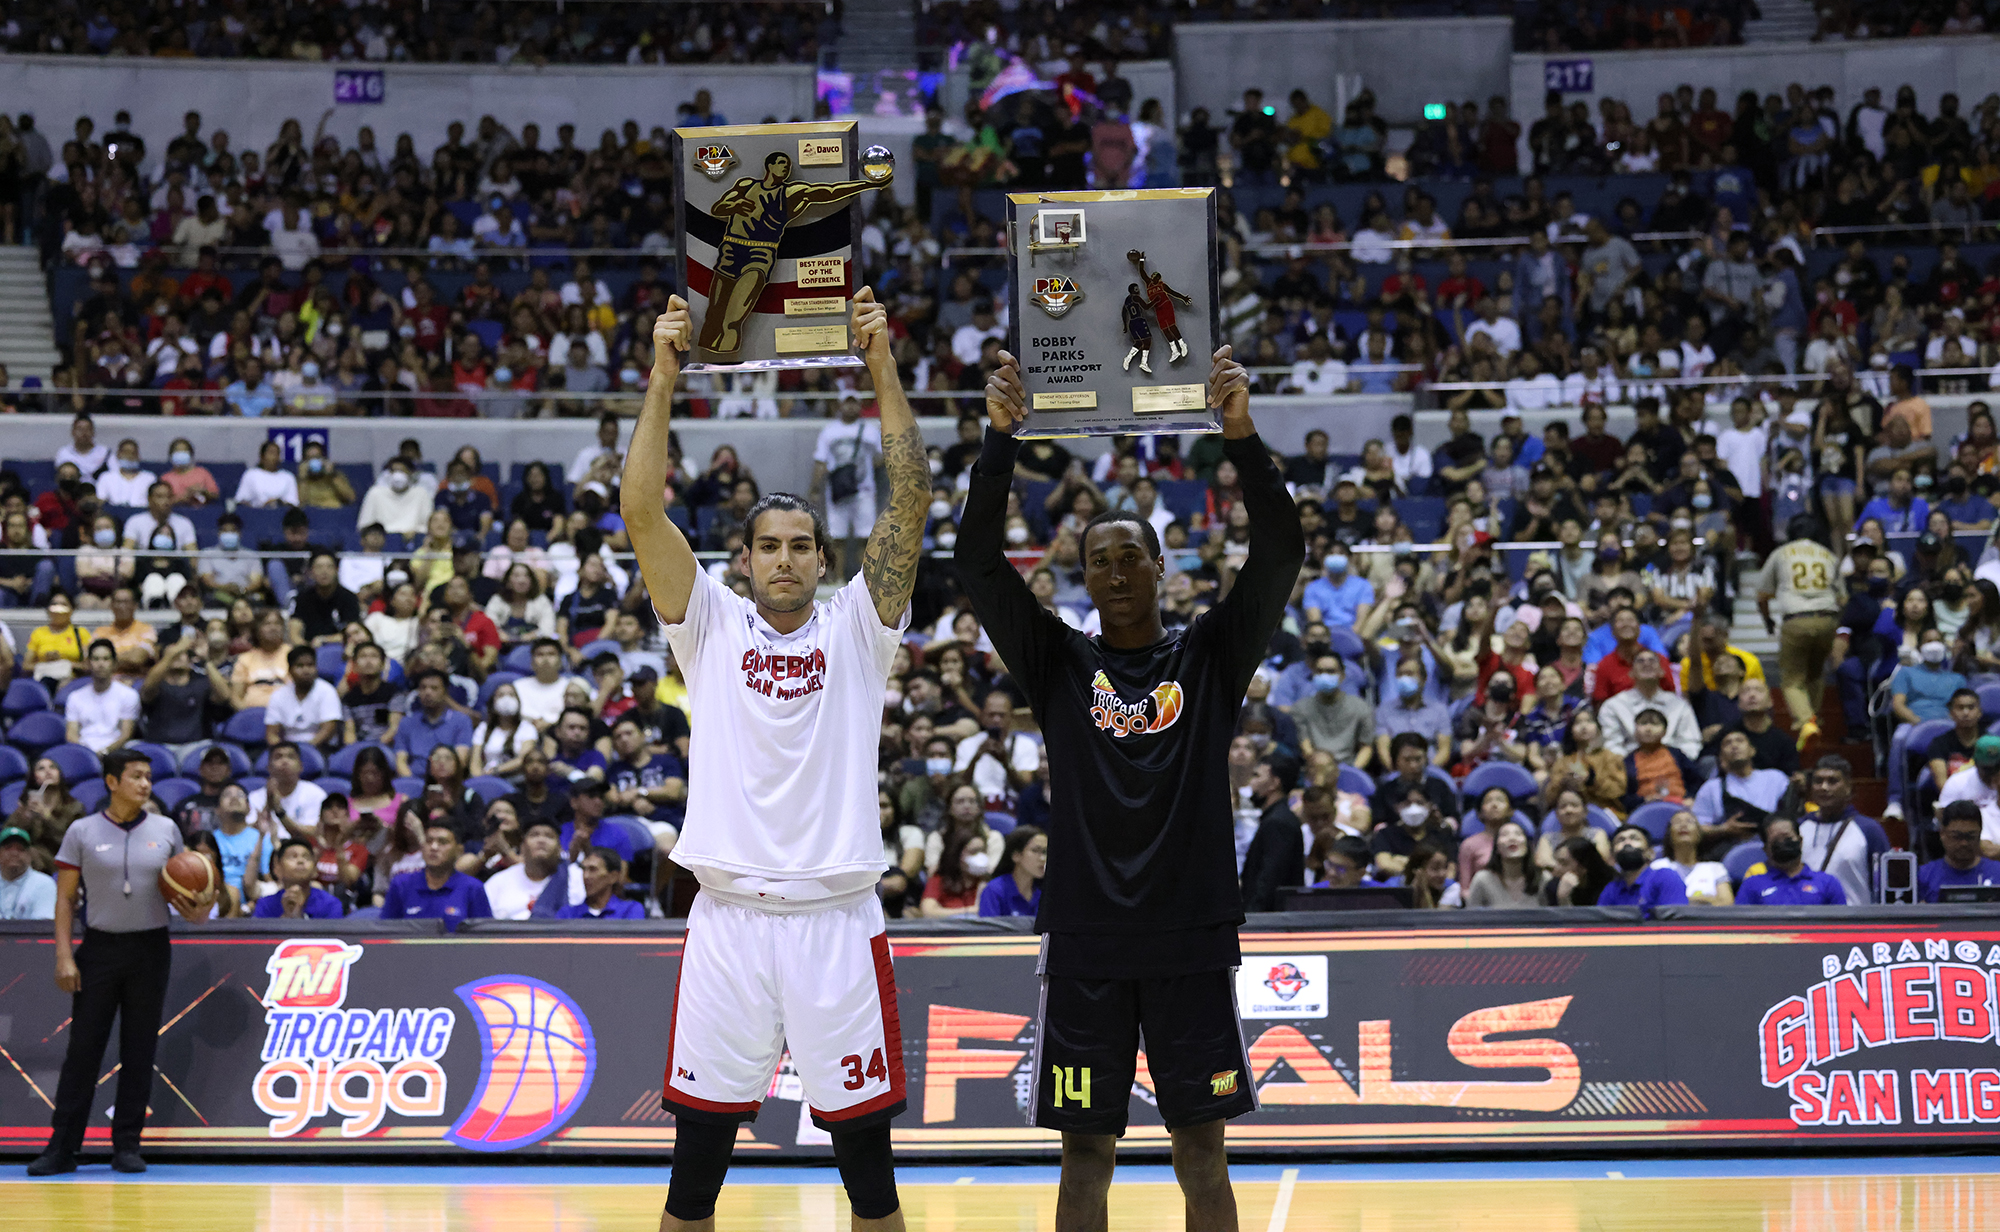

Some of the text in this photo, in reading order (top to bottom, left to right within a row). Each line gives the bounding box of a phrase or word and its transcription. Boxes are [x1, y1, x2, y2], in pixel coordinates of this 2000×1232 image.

[336, 75, 381, 98] 216
[1546, 64, 1590, 89] 217
[817, 146, 840, 154] Davco
[1033, 336, 1076, 348] BOBBY
[1028, 363, 1102, 374] BEST IMPORT
[1042, 350, 1085, 361] PARKS
[1047, 375, 1083, 384] AWARD
[1792, 562, 1827, 589] 23
[746, 671, 773, 697] SAN
[1093, 690, 1148, 715] TROPANG
[268, 949, 358, 1002] TNT
[261, 1008, 455, 1061] TROPANG
[1759, 962, 2000, 1088] GINEB
[840, 1047, 887, 1090] 34
[1052, 1064, 1091, 1108] 14
[1210, 1070, 1238, 1096] TNT
[253, 1060, 447, 1137] giga
[1789, 1070, 1902, 1126] SAN
